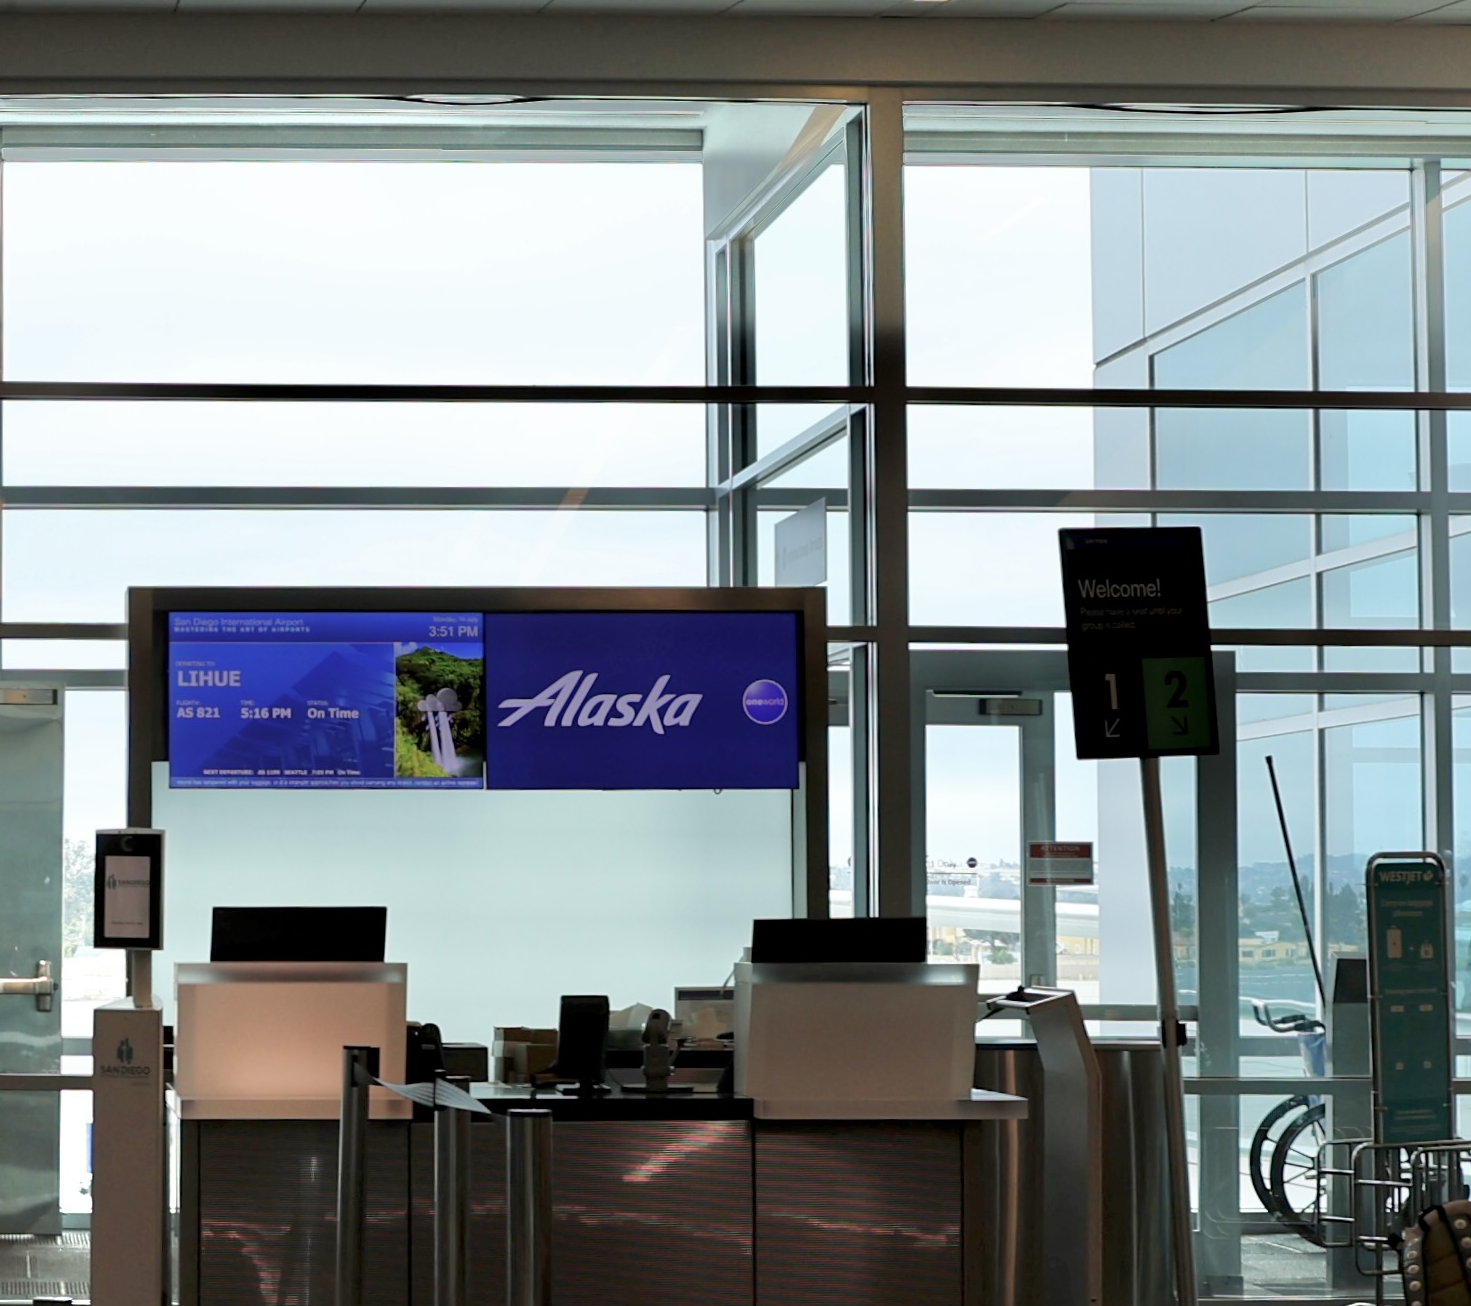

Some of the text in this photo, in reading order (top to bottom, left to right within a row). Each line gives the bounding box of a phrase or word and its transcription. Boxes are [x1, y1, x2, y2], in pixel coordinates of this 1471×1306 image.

[1077, 578, 1162, 599] Welcome!
[174, 618, 304, 628] San Diego International Airport
[429, 625, 478, 637] 3:51 PM
[177, 670, 241, 687] LIHUE
[1104, 673, 1119, 710] 1
[1164, 670, 1189, 709] 2
[497, 669, 703, 735] Alaska
[746, 697, 784, 706] oneworld
[177, 707, 220, 718] AS 821
[241, 707, 291, 719] 5:16 PM
[307, 708, 359, 719] On Time
[1379, 870, 1422, 884] WESTJET
